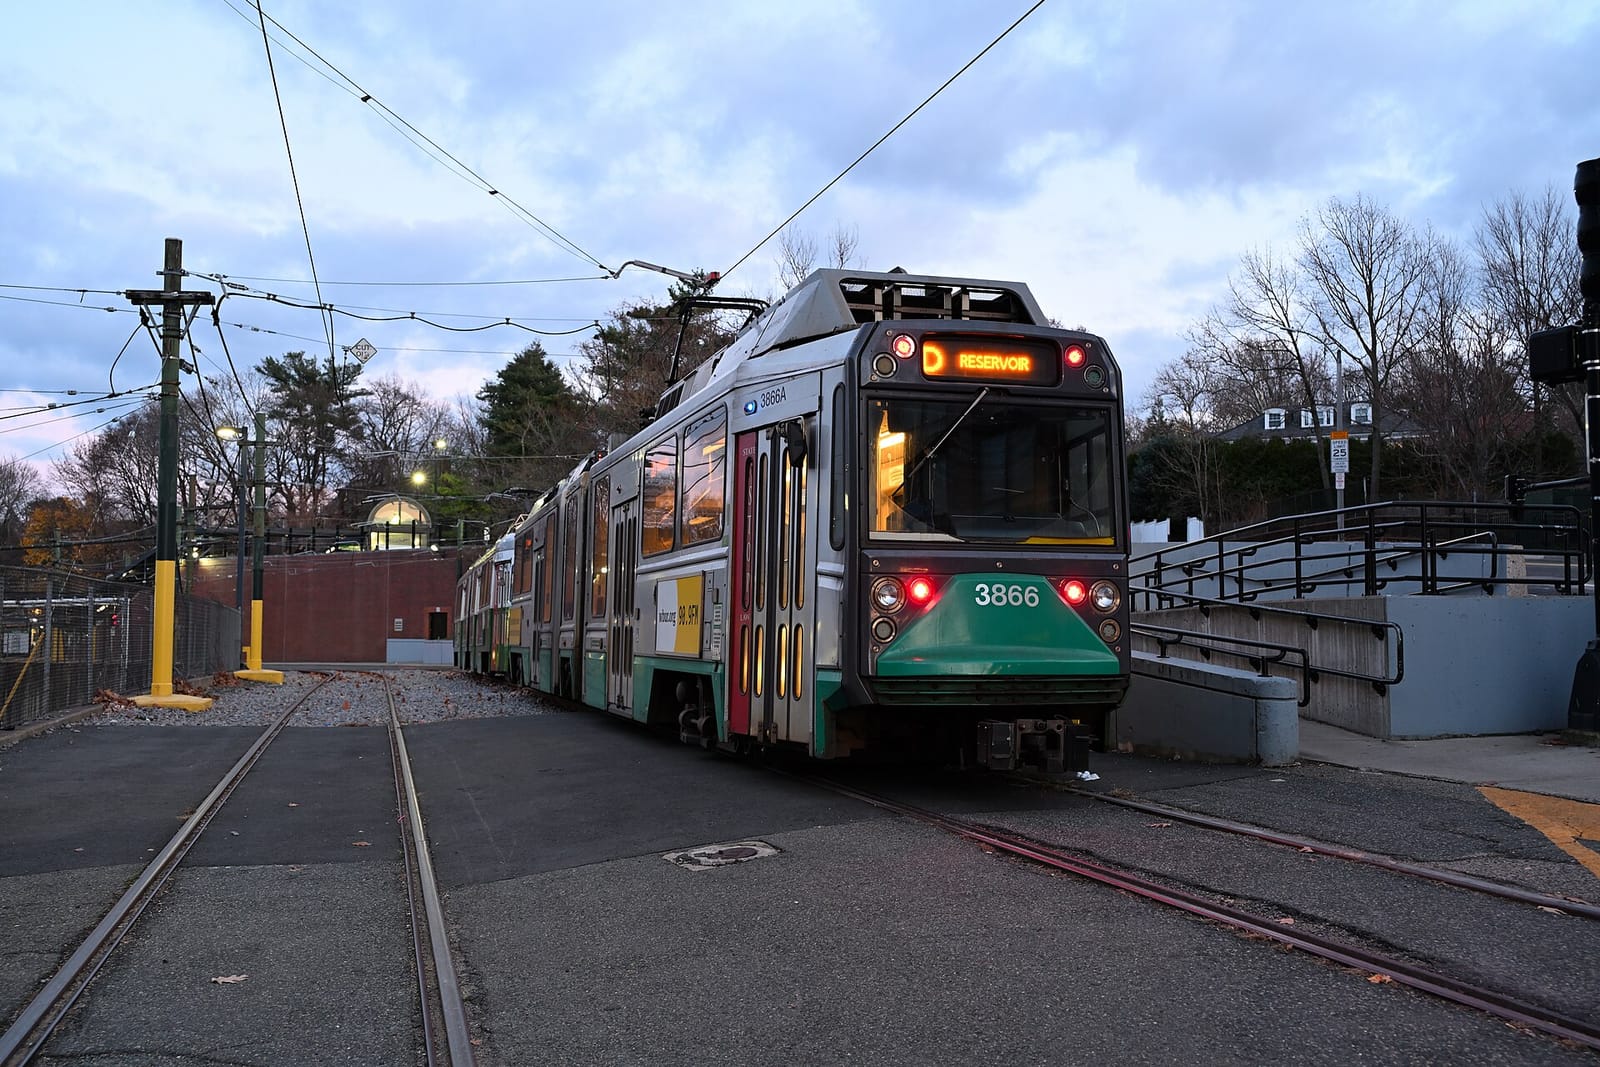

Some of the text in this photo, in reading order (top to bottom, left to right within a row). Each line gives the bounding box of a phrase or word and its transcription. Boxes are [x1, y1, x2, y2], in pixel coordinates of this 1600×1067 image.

[922, 342, 1031, 375] D RESERVOIR
[760, 386, 787, 409] 3866A
[1333, 449, 1346, 457] 25
[975, 583, 1040, 607] 3866
